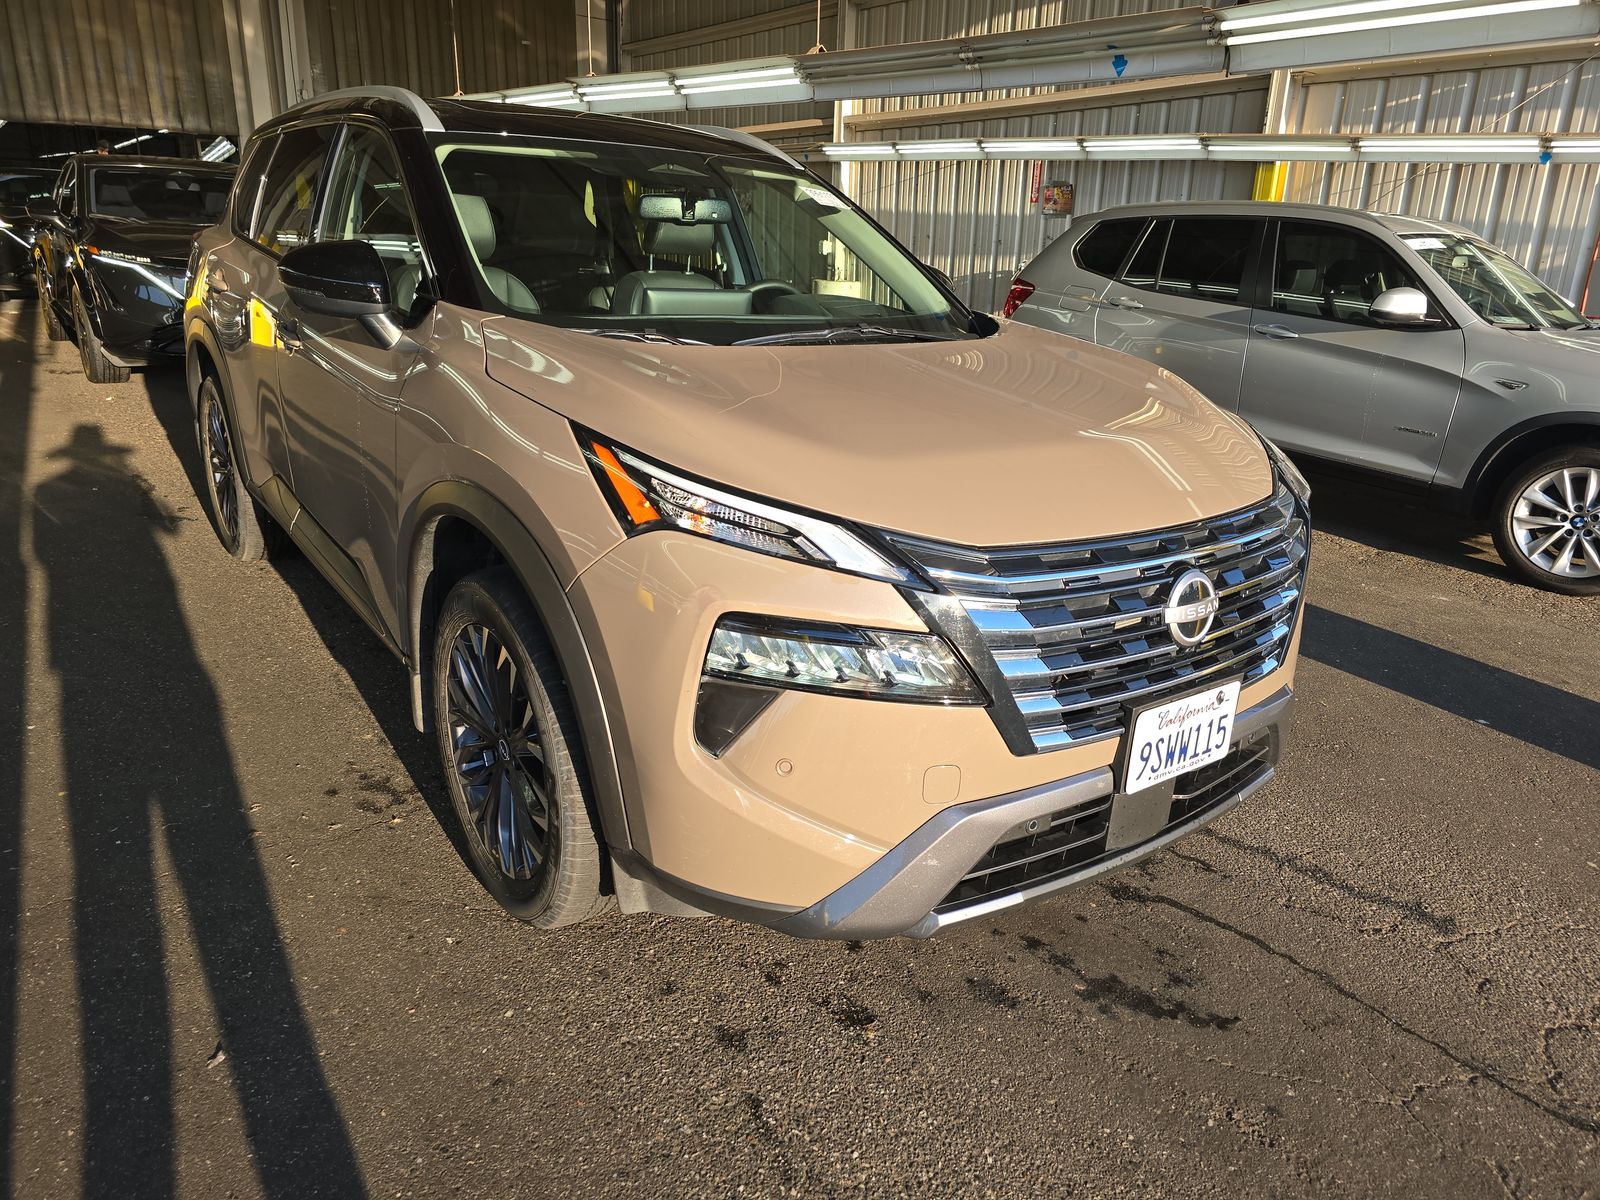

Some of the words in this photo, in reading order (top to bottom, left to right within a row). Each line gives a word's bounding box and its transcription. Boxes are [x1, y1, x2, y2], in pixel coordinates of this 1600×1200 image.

[1158, 698, 1220, 730] California
[1136, 714, 1228, 781] 9SWW115
[1153, 757, 1206, 781] dmv.ca.gov
